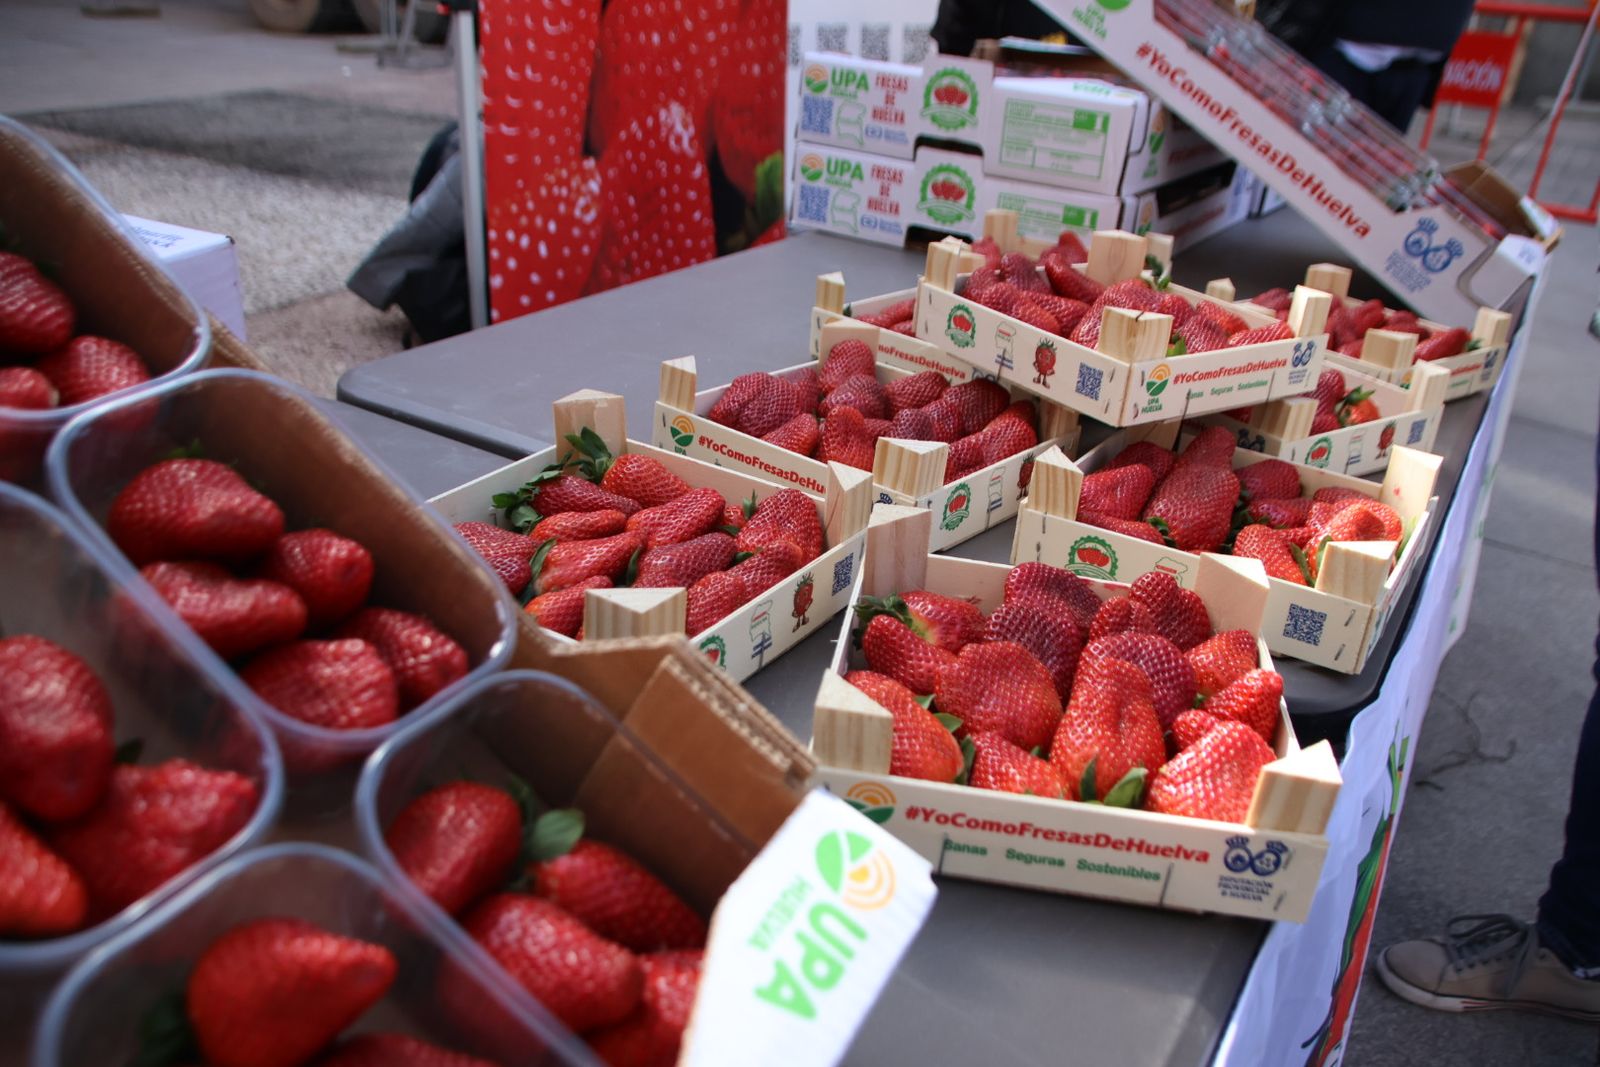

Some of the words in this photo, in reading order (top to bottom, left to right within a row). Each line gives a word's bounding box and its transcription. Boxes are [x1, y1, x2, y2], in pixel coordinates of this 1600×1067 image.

[830, 66, 869, 92] UPA
[875, 73, 908, 93] FRESAS
[871, 105, 906, 125] HUELVA
[1136, 42, 1372, 239] #YoComoFresasDeHuelva
[825, 154, 865, 181] UPA
[871, 164, 904, 185] FRESAS
[867, 195, 901, 217] HUELVA
[1173, 358, 1287, 385] #YoComoFresasDeHuelva
[698, 434, 826, 495] #YoComoFresasDeHu
[904, 804, 1210, 863] #YoComoFresasDeHuelva
[1005, 847, 1066, 869] Seguras
[1076, 857, 1162, 882] Sostenibles
[754, 902, 868, 1020] UPA
